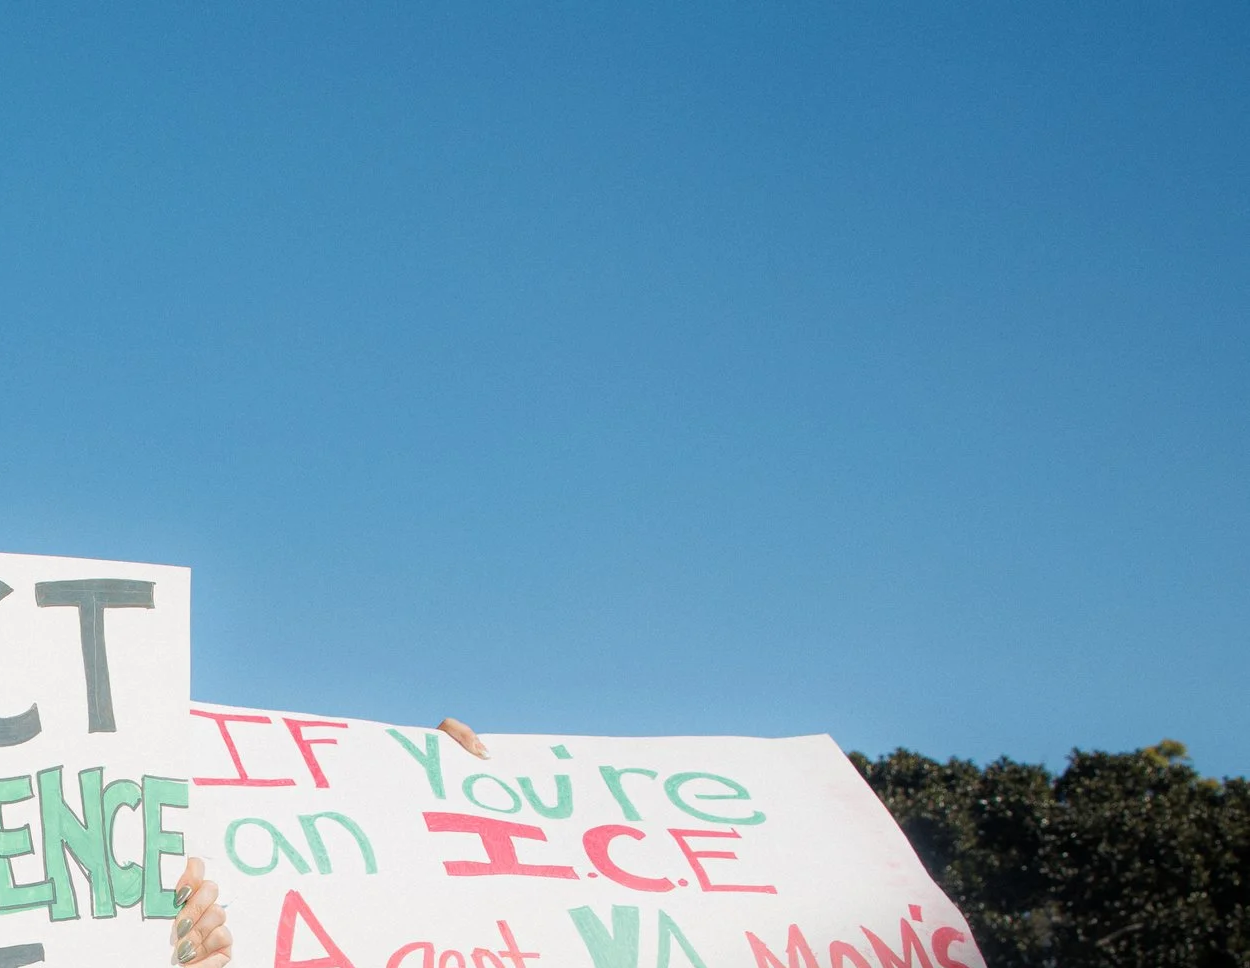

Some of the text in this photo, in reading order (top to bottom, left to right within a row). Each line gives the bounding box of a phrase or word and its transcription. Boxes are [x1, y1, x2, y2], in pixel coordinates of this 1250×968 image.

[190, 709, 768, 826] IF You're
[224, 811, 379, 876] an
